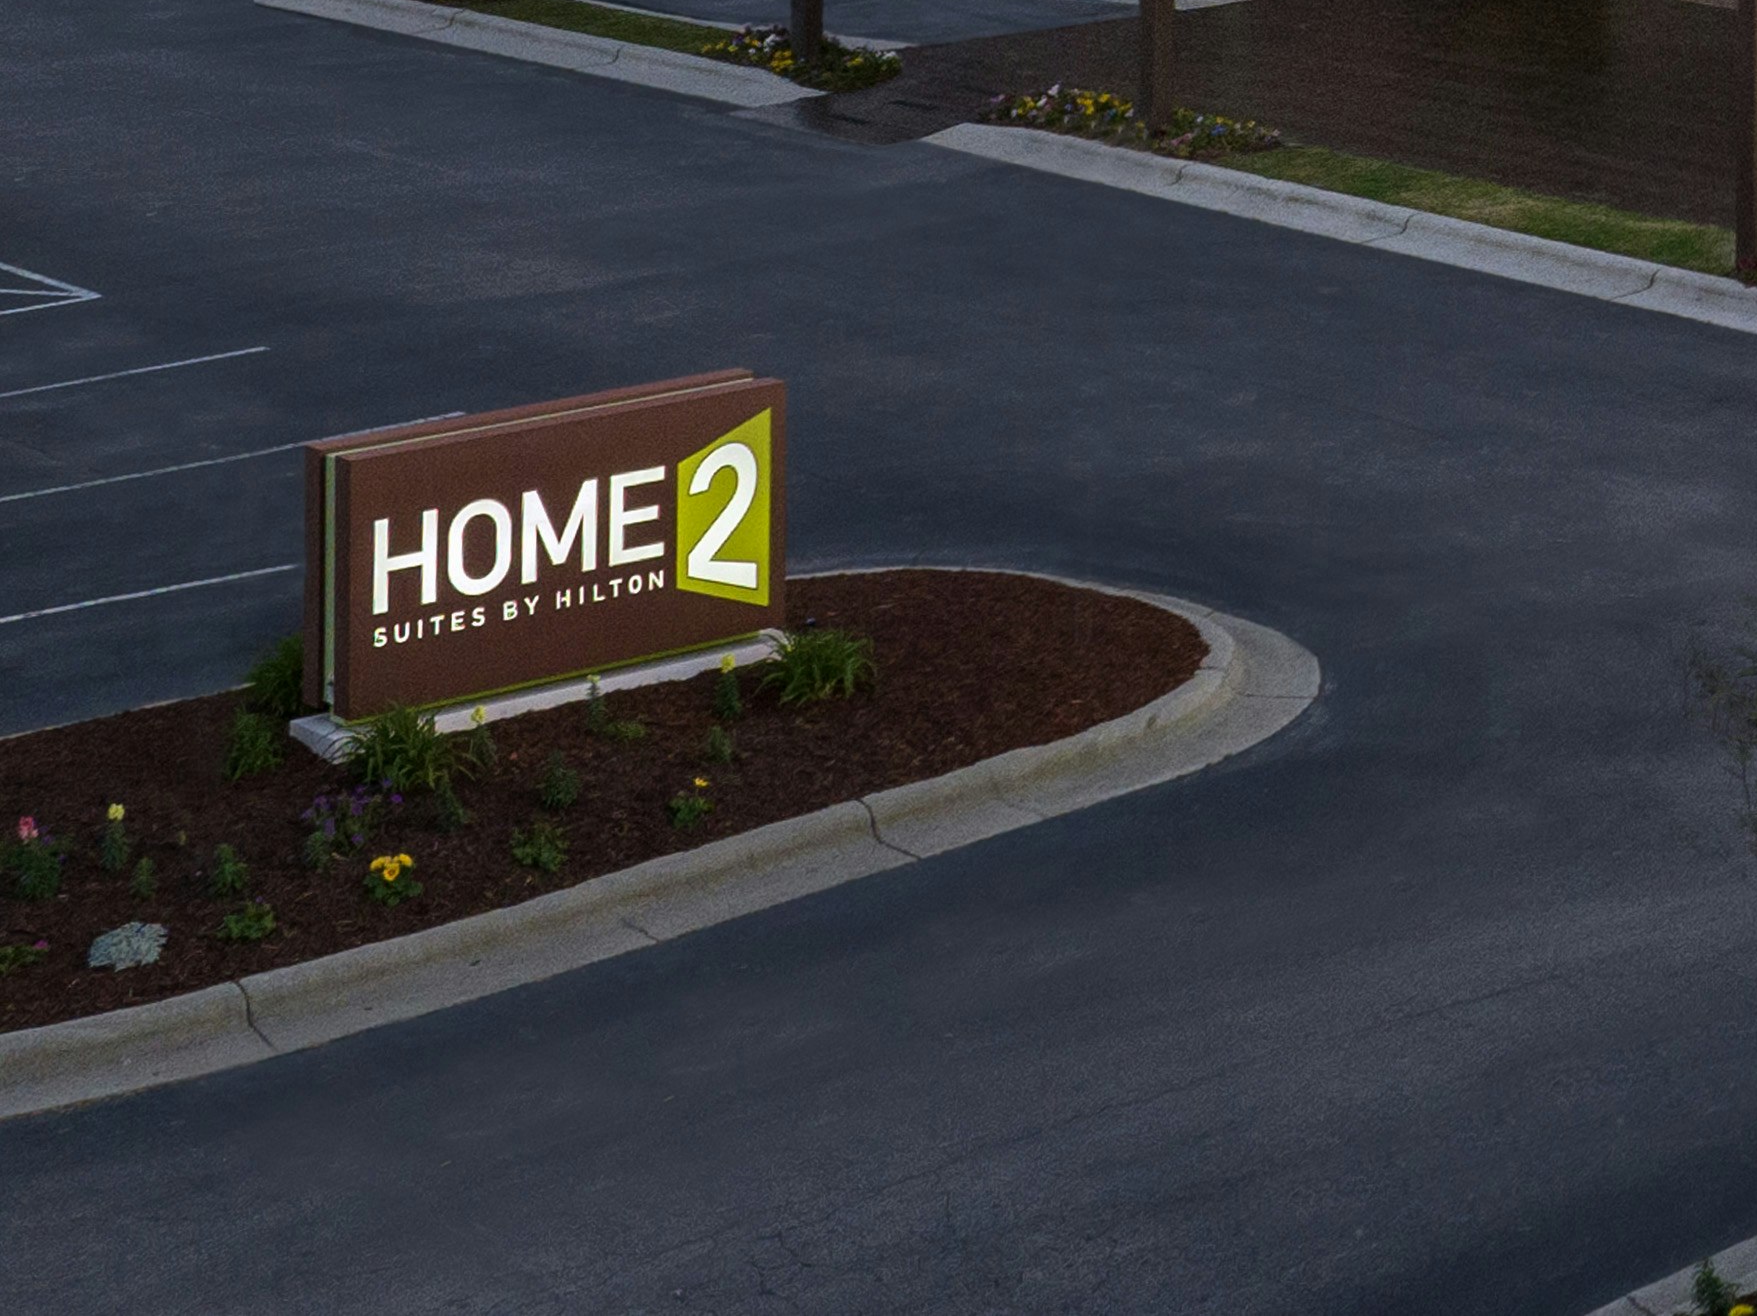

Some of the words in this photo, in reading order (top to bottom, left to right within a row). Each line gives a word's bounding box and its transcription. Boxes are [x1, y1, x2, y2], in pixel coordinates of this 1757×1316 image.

[373, 607, 486, 648] SUITES
[502, 595, 540, 621] BY
[556, 569, 664, 610] HILTON
